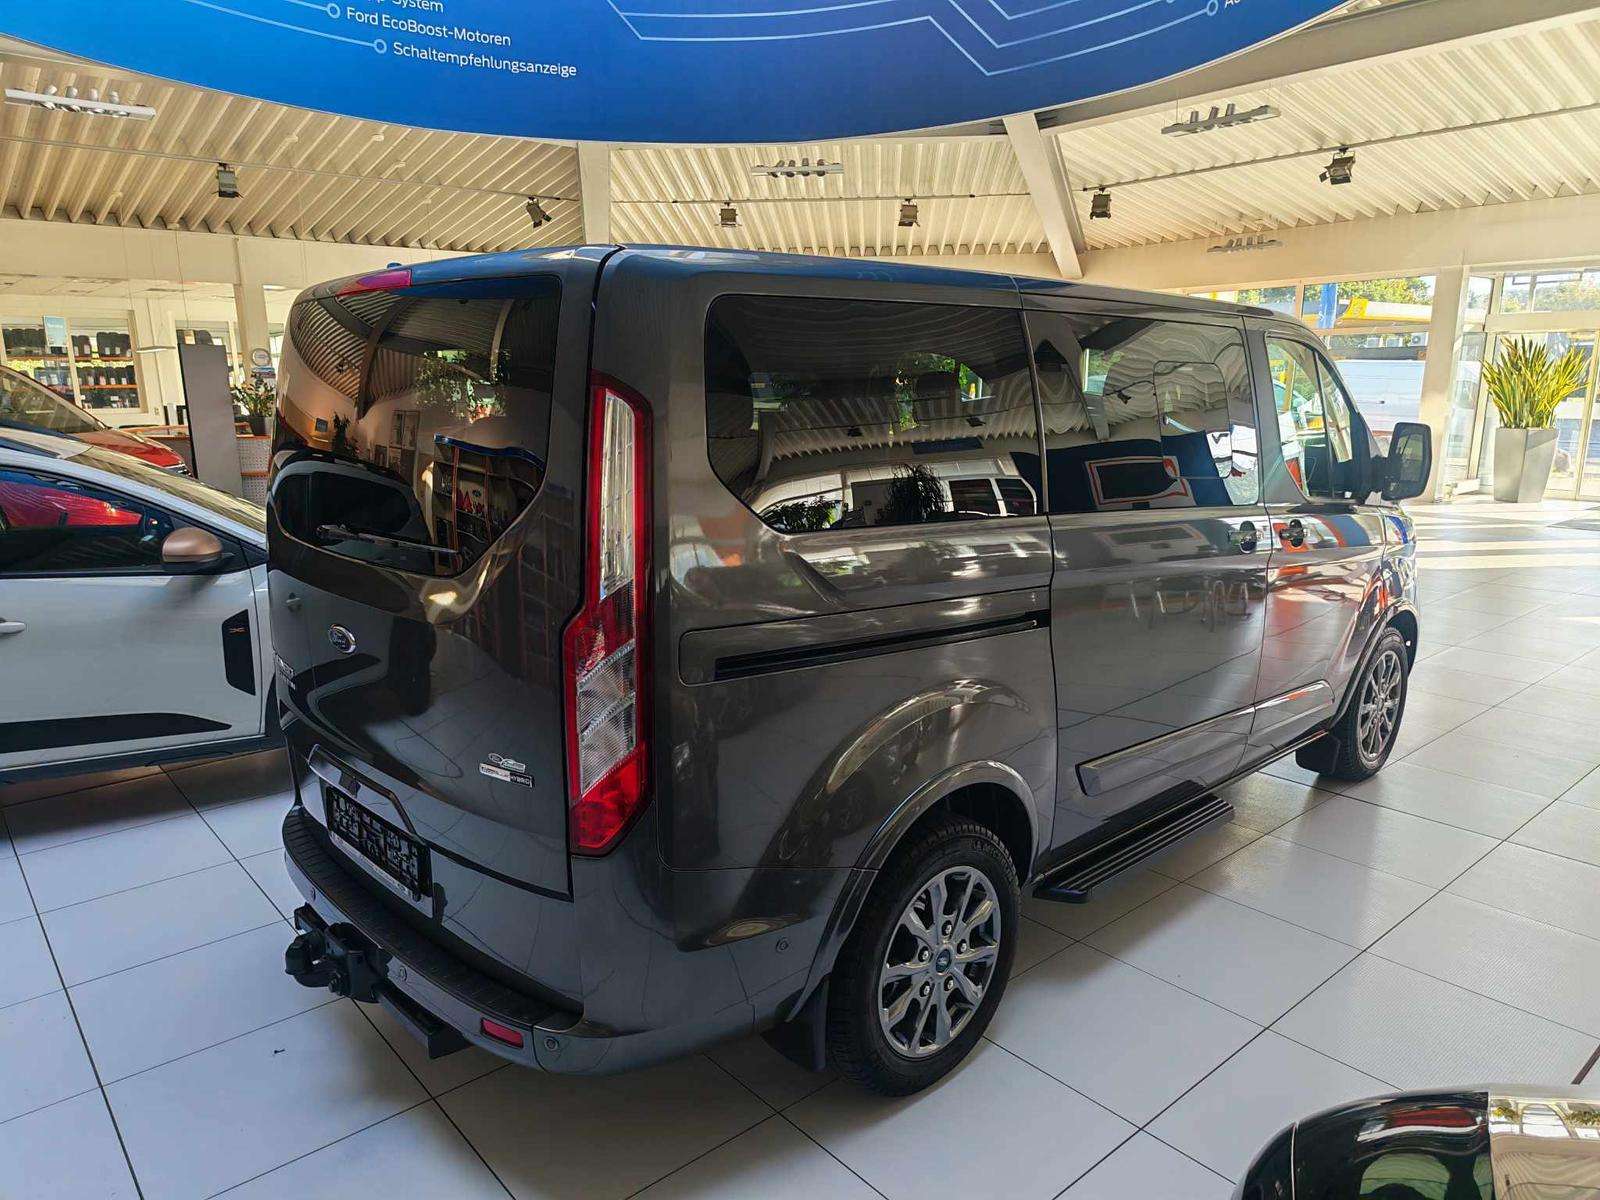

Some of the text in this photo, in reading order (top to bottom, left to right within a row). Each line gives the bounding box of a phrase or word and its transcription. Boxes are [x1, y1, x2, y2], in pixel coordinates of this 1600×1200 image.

[347, 8, 511, 46] Ford EcoBoost-Motoren
[393, 43, 577, 76] Schaltempfehlungsanzeige
